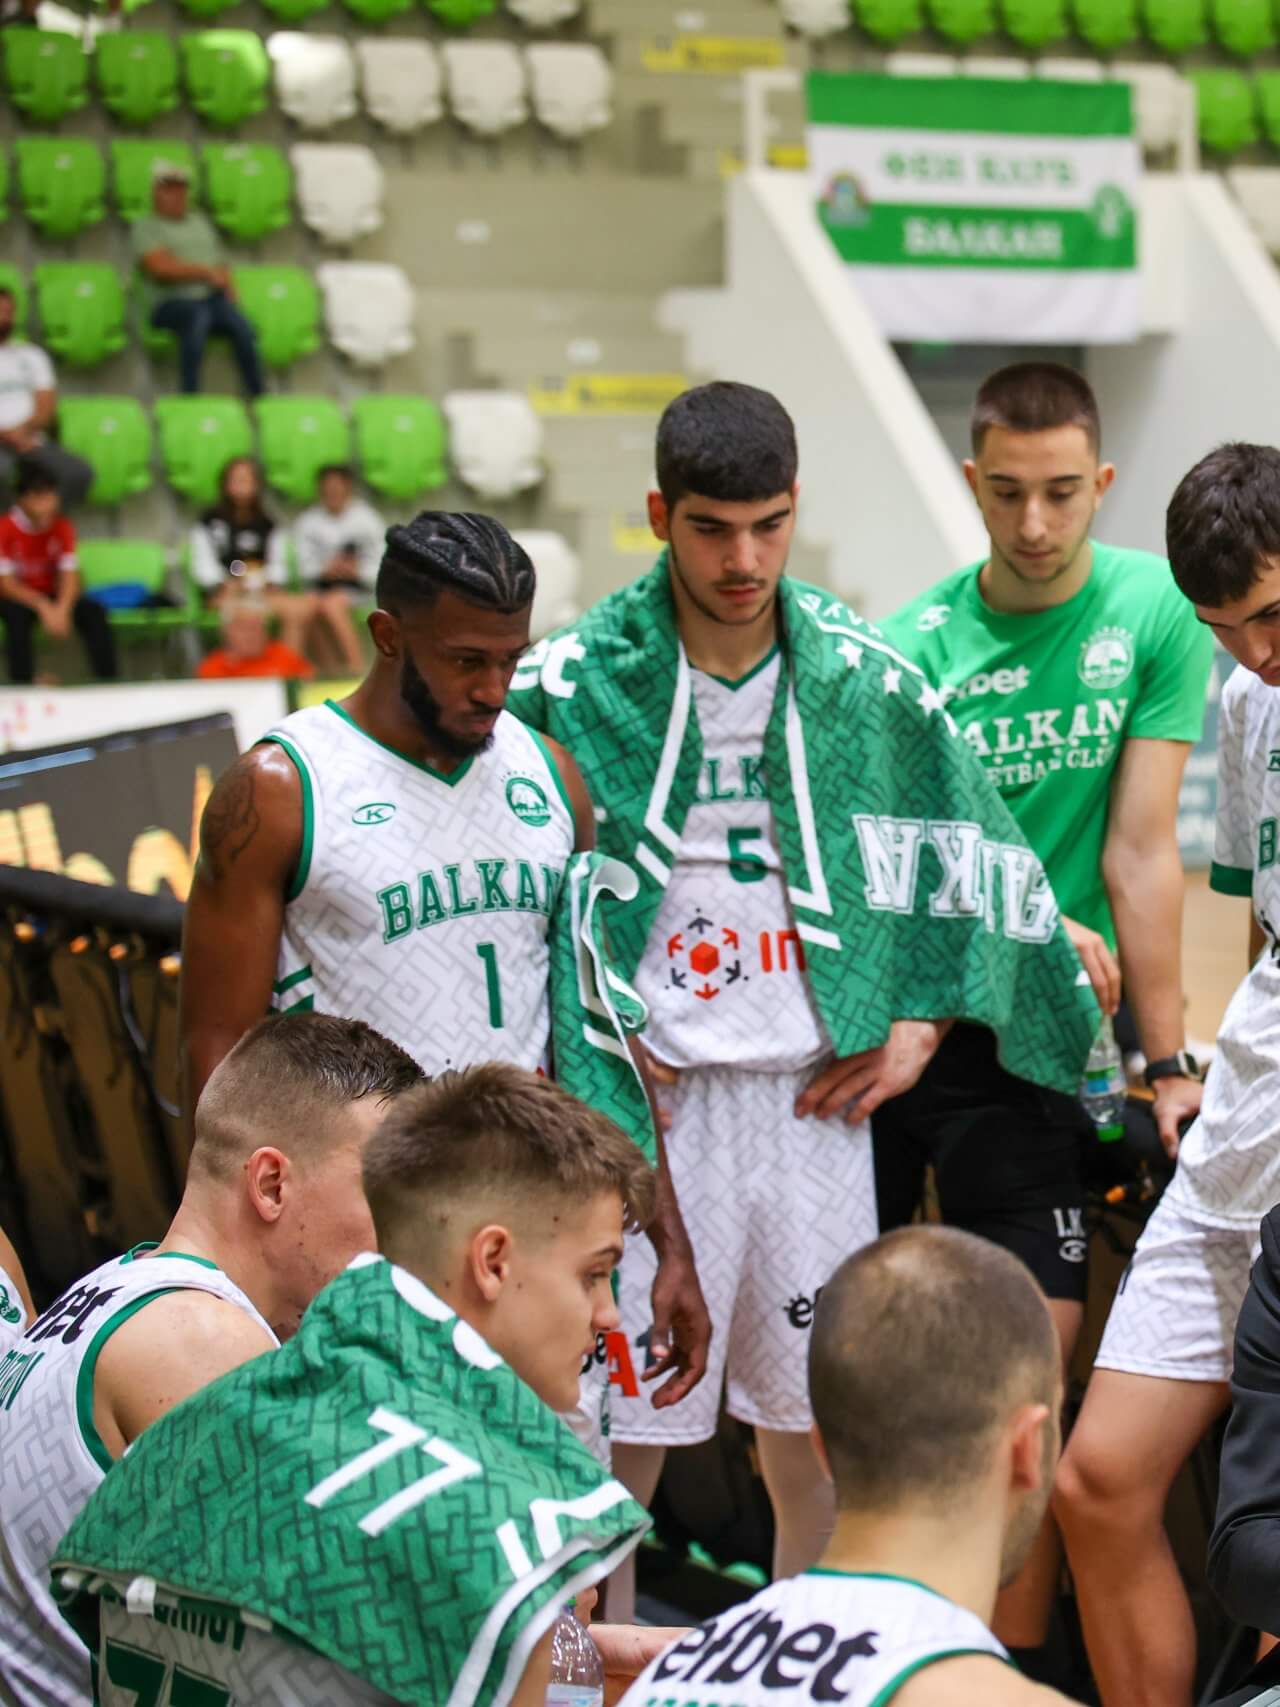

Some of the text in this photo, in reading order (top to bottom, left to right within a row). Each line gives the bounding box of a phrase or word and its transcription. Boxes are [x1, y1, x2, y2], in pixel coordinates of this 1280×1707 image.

[963, 698, 1128, 757] ALKAN
[728, 827, 767, 883] 5
[476, 941, 504, 1030] 1
[304, 1406, 483, 1537] 77
